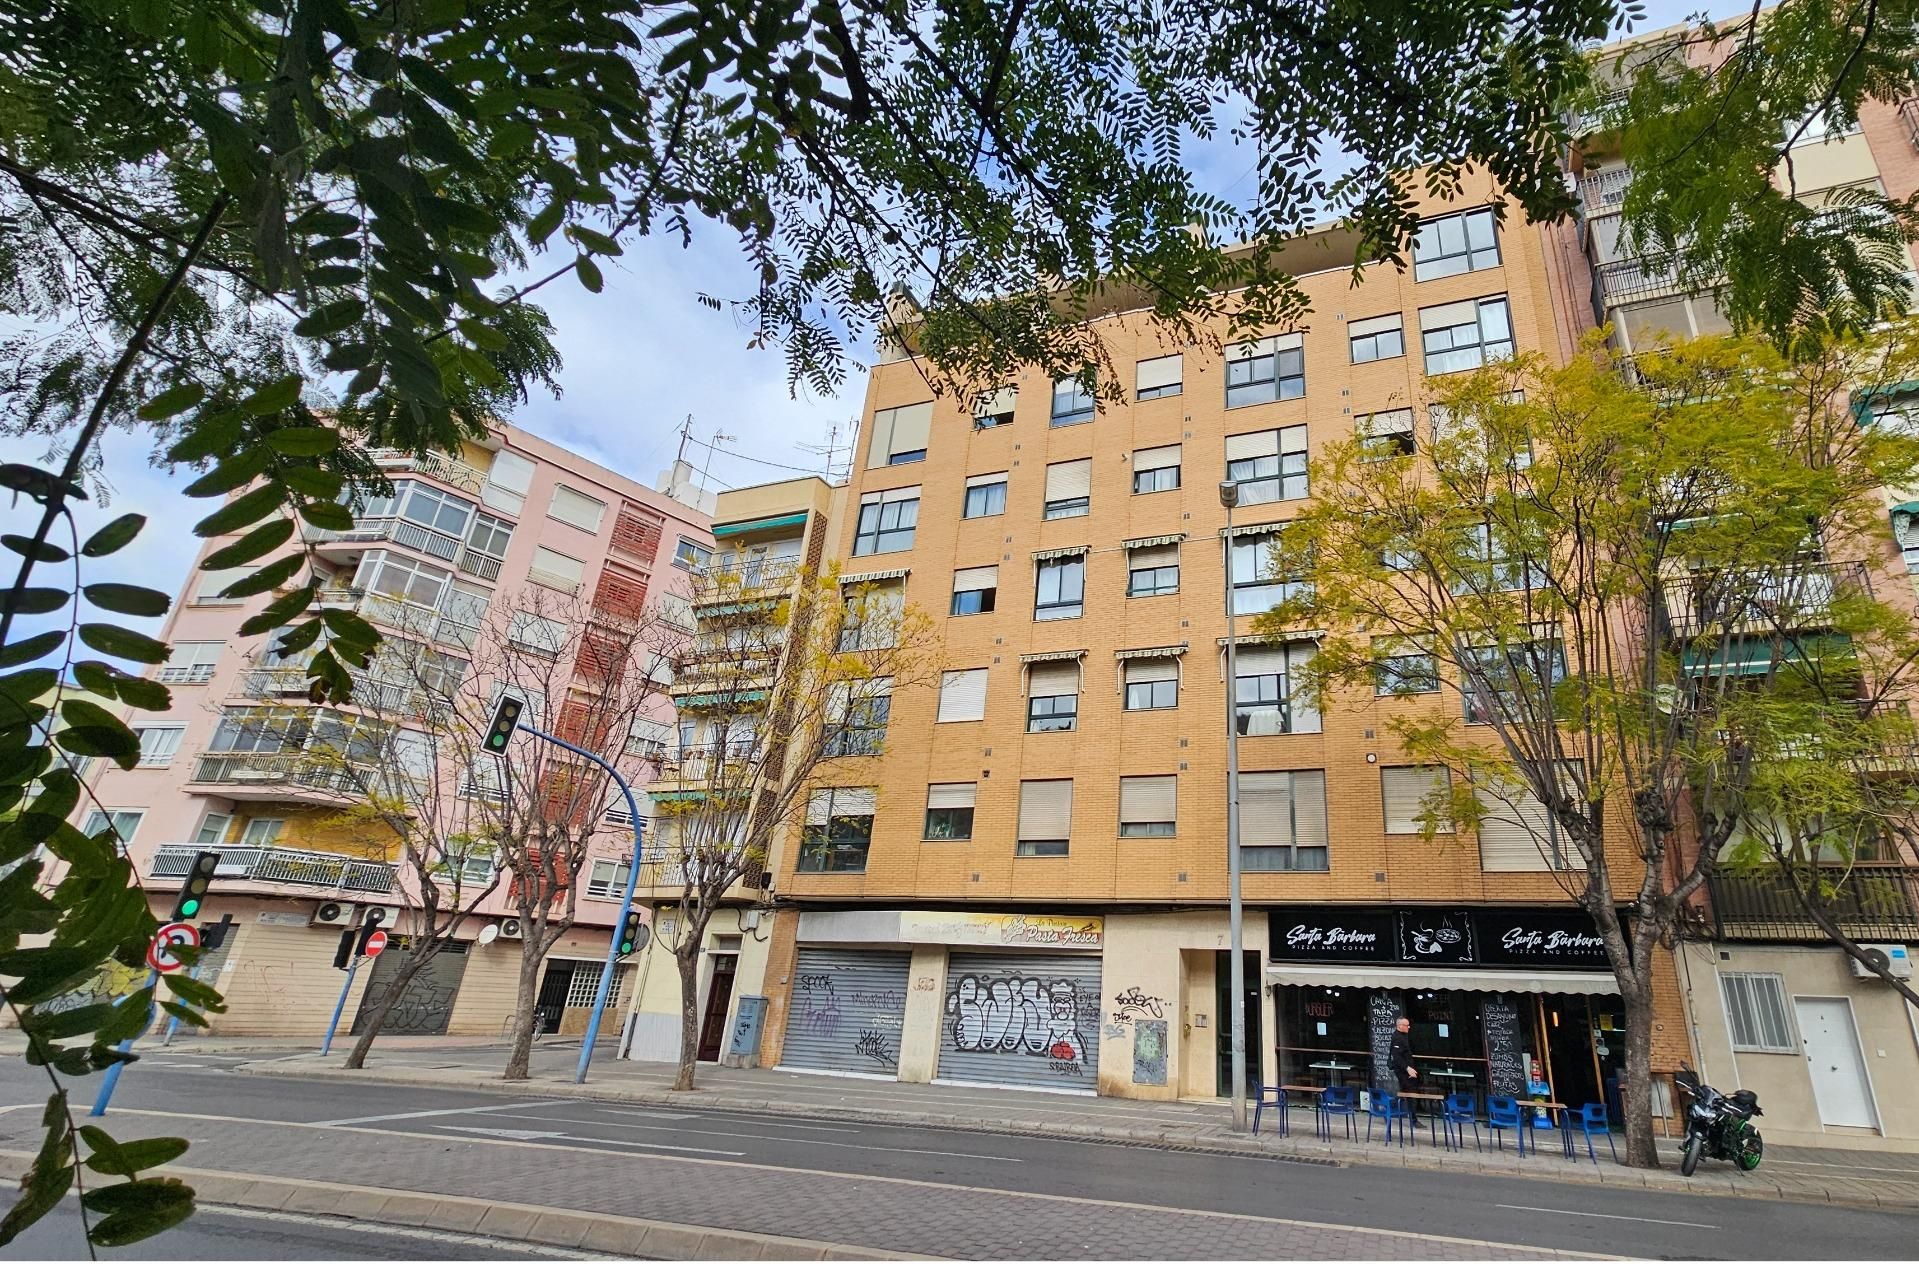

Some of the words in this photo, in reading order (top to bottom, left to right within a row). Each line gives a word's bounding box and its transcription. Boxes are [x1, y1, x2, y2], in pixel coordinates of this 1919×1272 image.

[1027, 924, 1060, 942] Pasta
[1062, 926, 1099, 945] Fresca
[1217, 935, 1224, 946] 7
[1286, 924, 1323, 945] Santa
[1501, 926, 1543, 949] Santa
